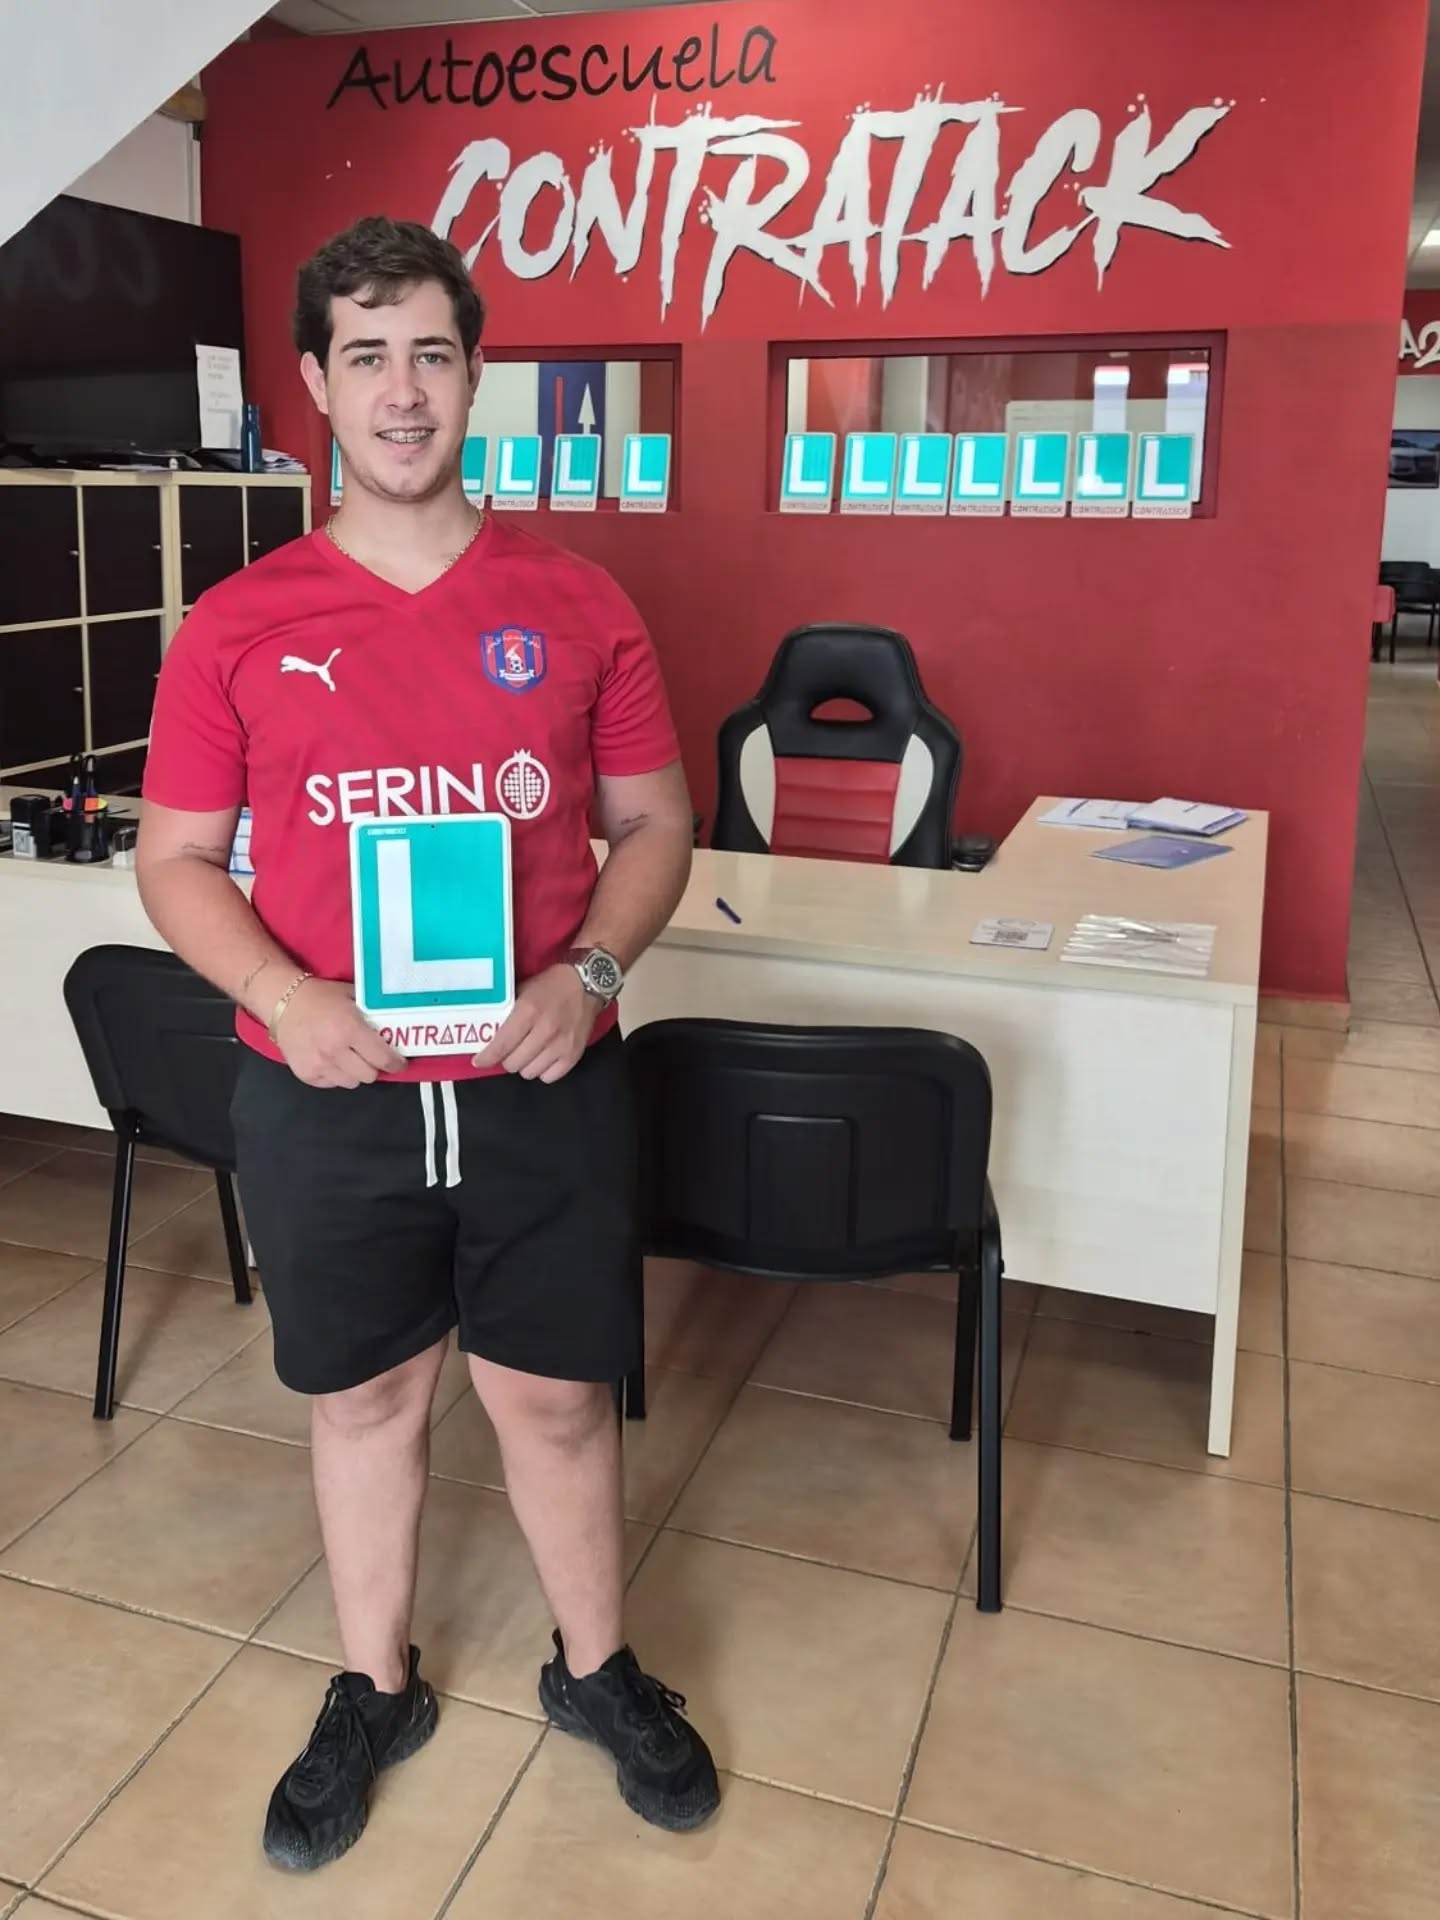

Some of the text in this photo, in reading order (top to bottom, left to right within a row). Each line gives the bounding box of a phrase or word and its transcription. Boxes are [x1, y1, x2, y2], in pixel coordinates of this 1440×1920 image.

[326, 23, 777, 110] Autoescuela
[431, 83, 1234, 334] CONTRATACK
[498, 440, 534, 492] L
[557, 440, 593, 493] L
[627, 440, 663, 493] L
[788, 438, 827, 494] L
[848, 438, 888, 494] L
[902, 439, 942, 495] L
[958, 439, 1000, 496] L
[1018, 438, 1061, 495] L
[1077, 439, 1124, 496] L
[1142, 440, 1186, 497] L
[376, 838, 494, 995] L
[379, 1021, 501, 1048] ONTRATAC
